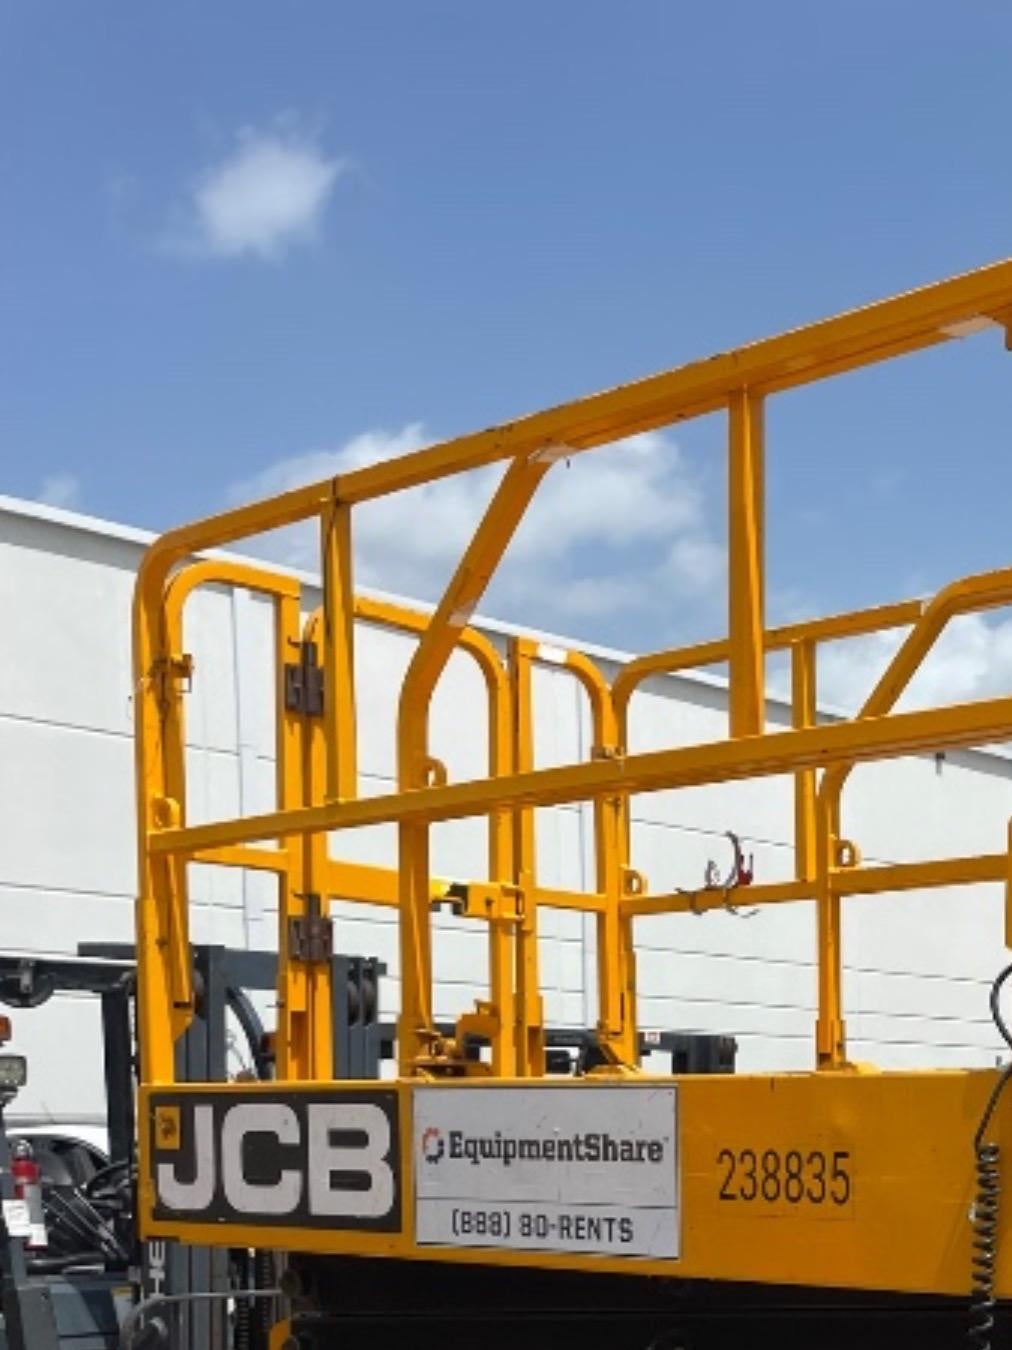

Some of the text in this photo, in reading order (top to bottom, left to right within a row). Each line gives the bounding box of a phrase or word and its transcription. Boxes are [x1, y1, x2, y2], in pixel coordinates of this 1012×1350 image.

[157, 1102, 394, 1219] JCB
[449, 1130, 665, 1166] EquipmentShare
[717, 1147, 851, 1206] 238835
[451, 1209, 634, 1243] (888) 80-RENTS
